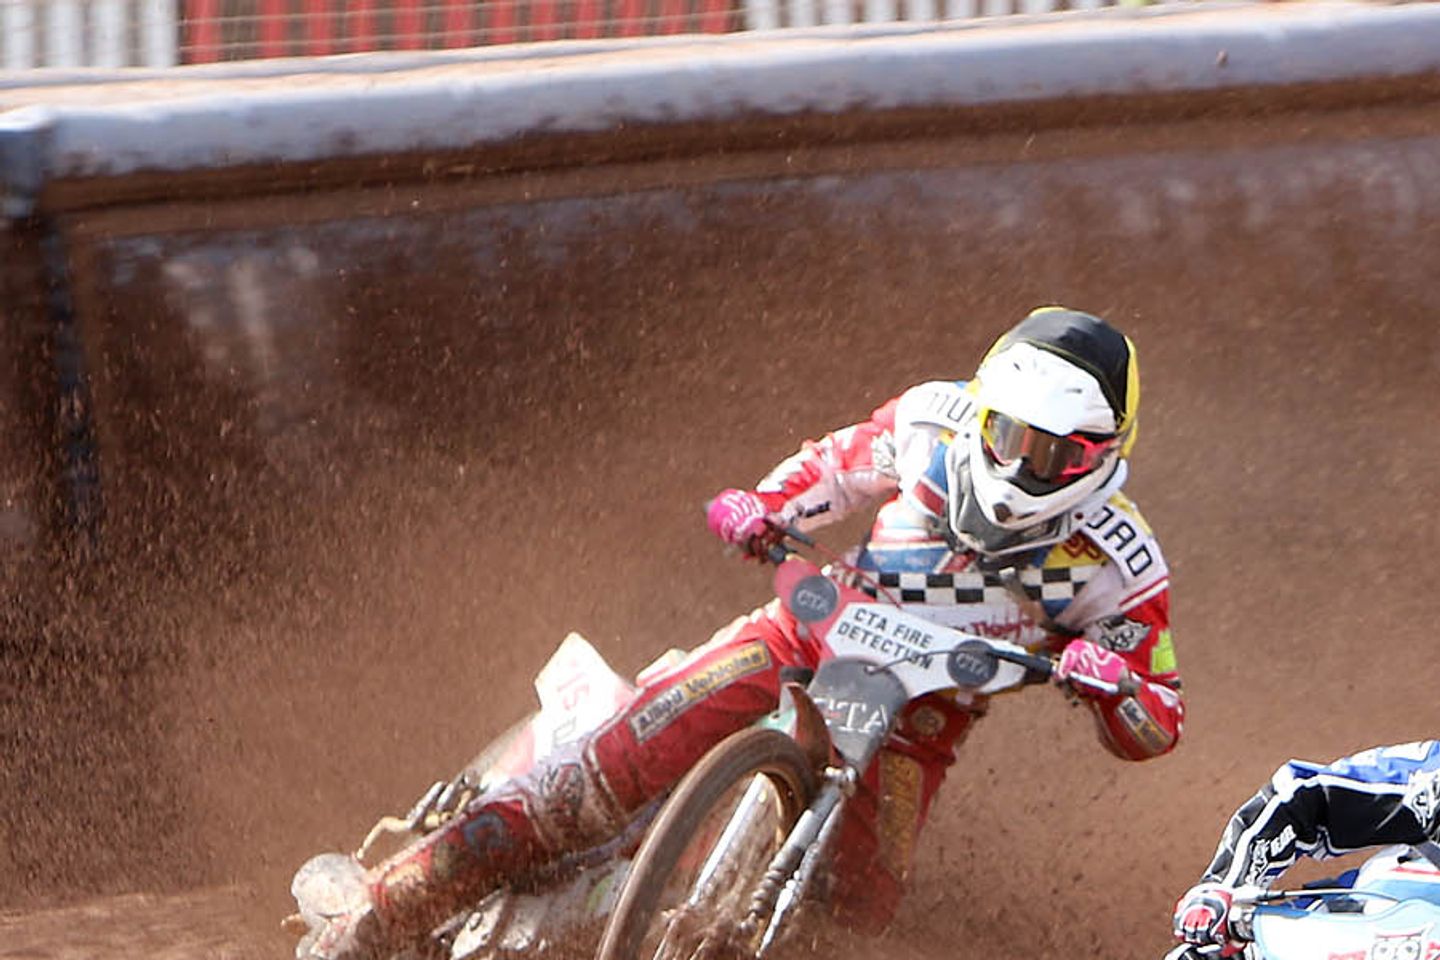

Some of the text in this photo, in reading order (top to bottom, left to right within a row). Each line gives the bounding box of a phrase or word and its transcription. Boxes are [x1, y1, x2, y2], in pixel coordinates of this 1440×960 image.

[837, 617, 934, 671] DETECTION
[854, 607, 934, 649] CTA FIRE
[954, 650, 989, 677] CTA
